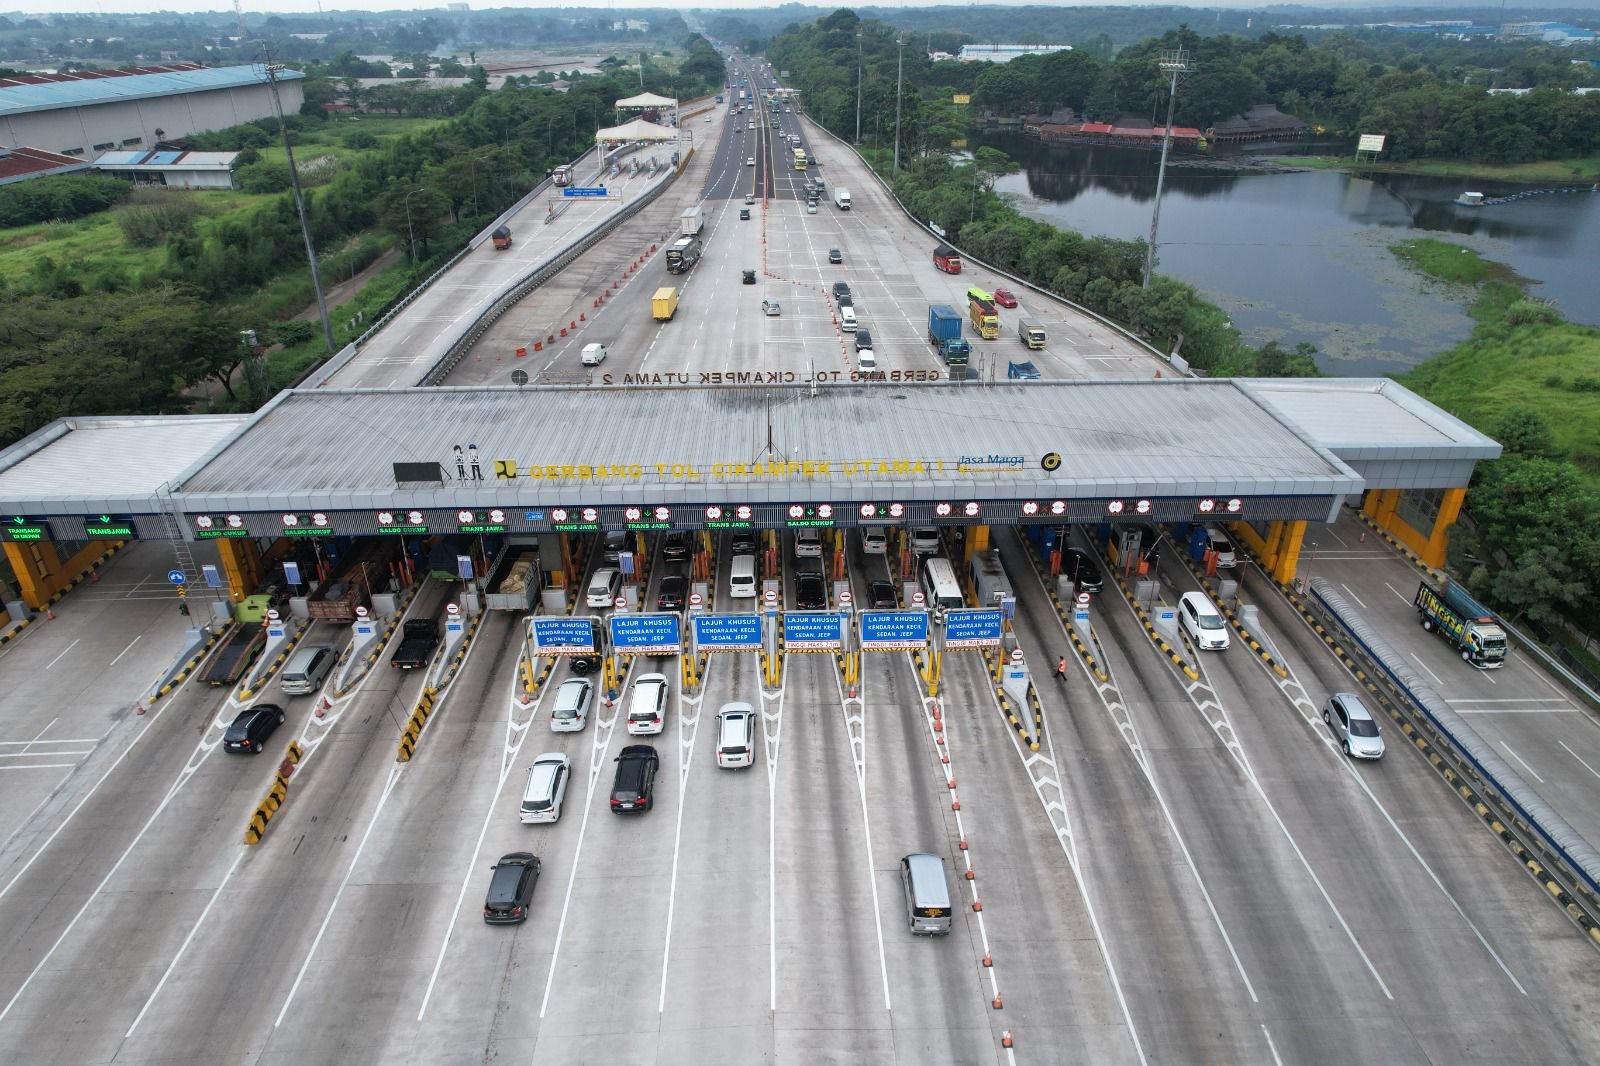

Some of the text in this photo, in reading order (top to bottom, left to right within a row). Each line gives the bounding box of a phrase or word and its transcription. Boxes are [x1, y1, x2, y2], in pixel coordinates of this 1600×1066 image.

[960, 454, 1024, 466] Jasa Marga
[529, 464, 642, 479] GERBANG
[654, 463, 701, 478] TOL
[712, 462, 831, 477] CIKAMPEK
[844, 460, 924, 476] UTAMA
